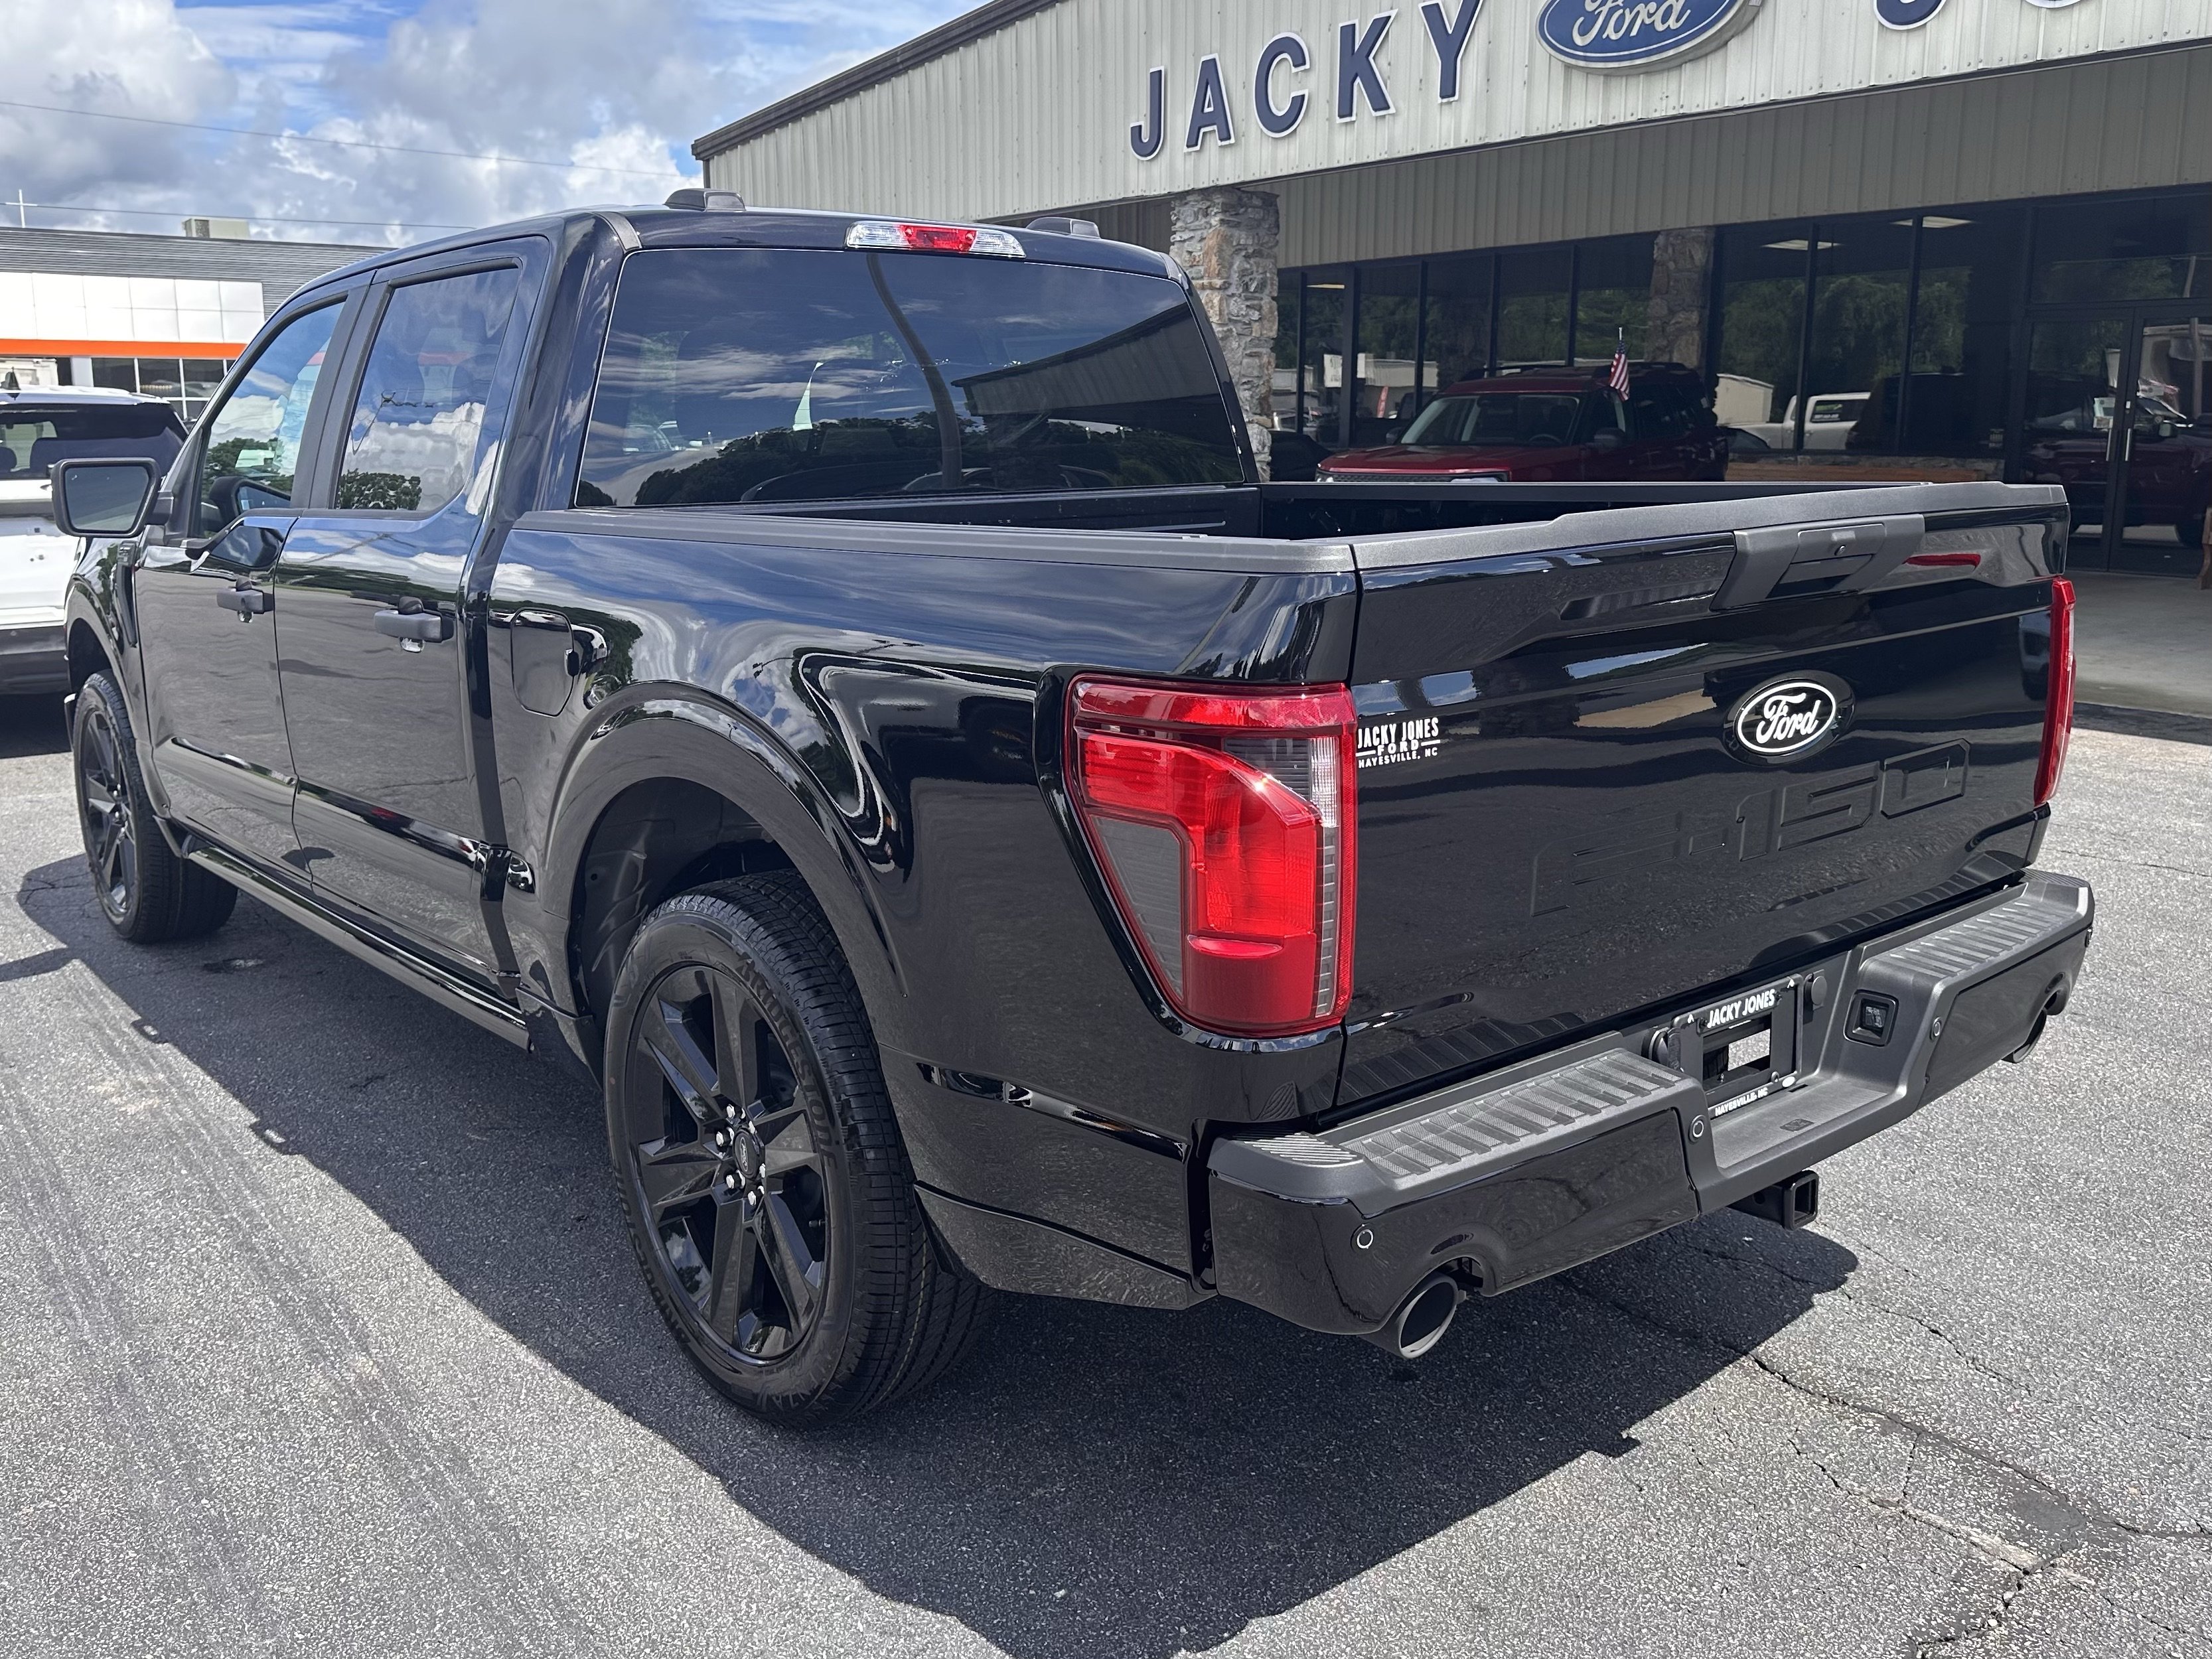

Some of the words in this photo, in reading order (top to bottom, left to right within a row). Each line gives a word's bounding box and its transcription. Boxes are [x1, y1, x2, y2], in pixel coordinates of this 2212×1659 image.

[1130, 0, 1483, 161] JACKY
[1357, 724, 1396, 749] JACKY
[1402, 717, 1439, 741] JONES
[1756, 692, 1822, 744] Ford
[1377, 739, 1419, 756] FORD
[1425, 747, 1438, 757] NC
[1530, 738, 1971, 918] F-150
[1707, 1000, 1742, 1029] JACKY
[1742, 988, 1775, 1017] JONES
[1757, 1087, 1769, 1098] NC
